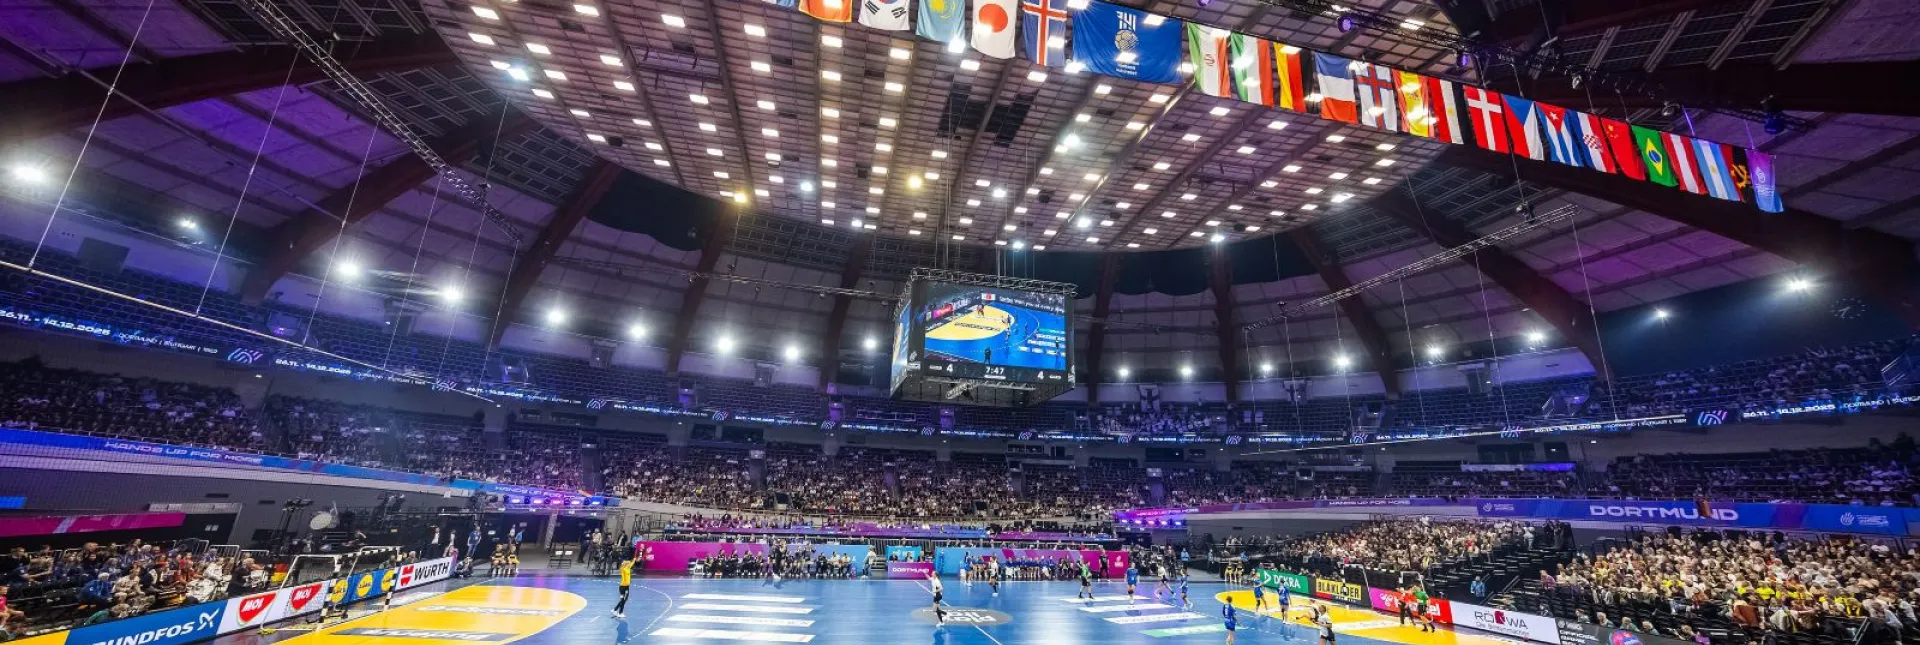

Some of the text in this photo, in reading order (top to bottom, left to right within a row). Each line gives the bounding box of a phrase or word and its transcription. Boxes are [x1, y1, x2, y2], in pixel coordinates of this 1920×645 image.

[985, 366, 1005, 375] 7:47
[105, 440, 163, 454] HANDS
[165, 447, 187, 455] UP
[190, 450, 222, 460] FOR
[1589, 504, 1739, 521] DORTMUND
